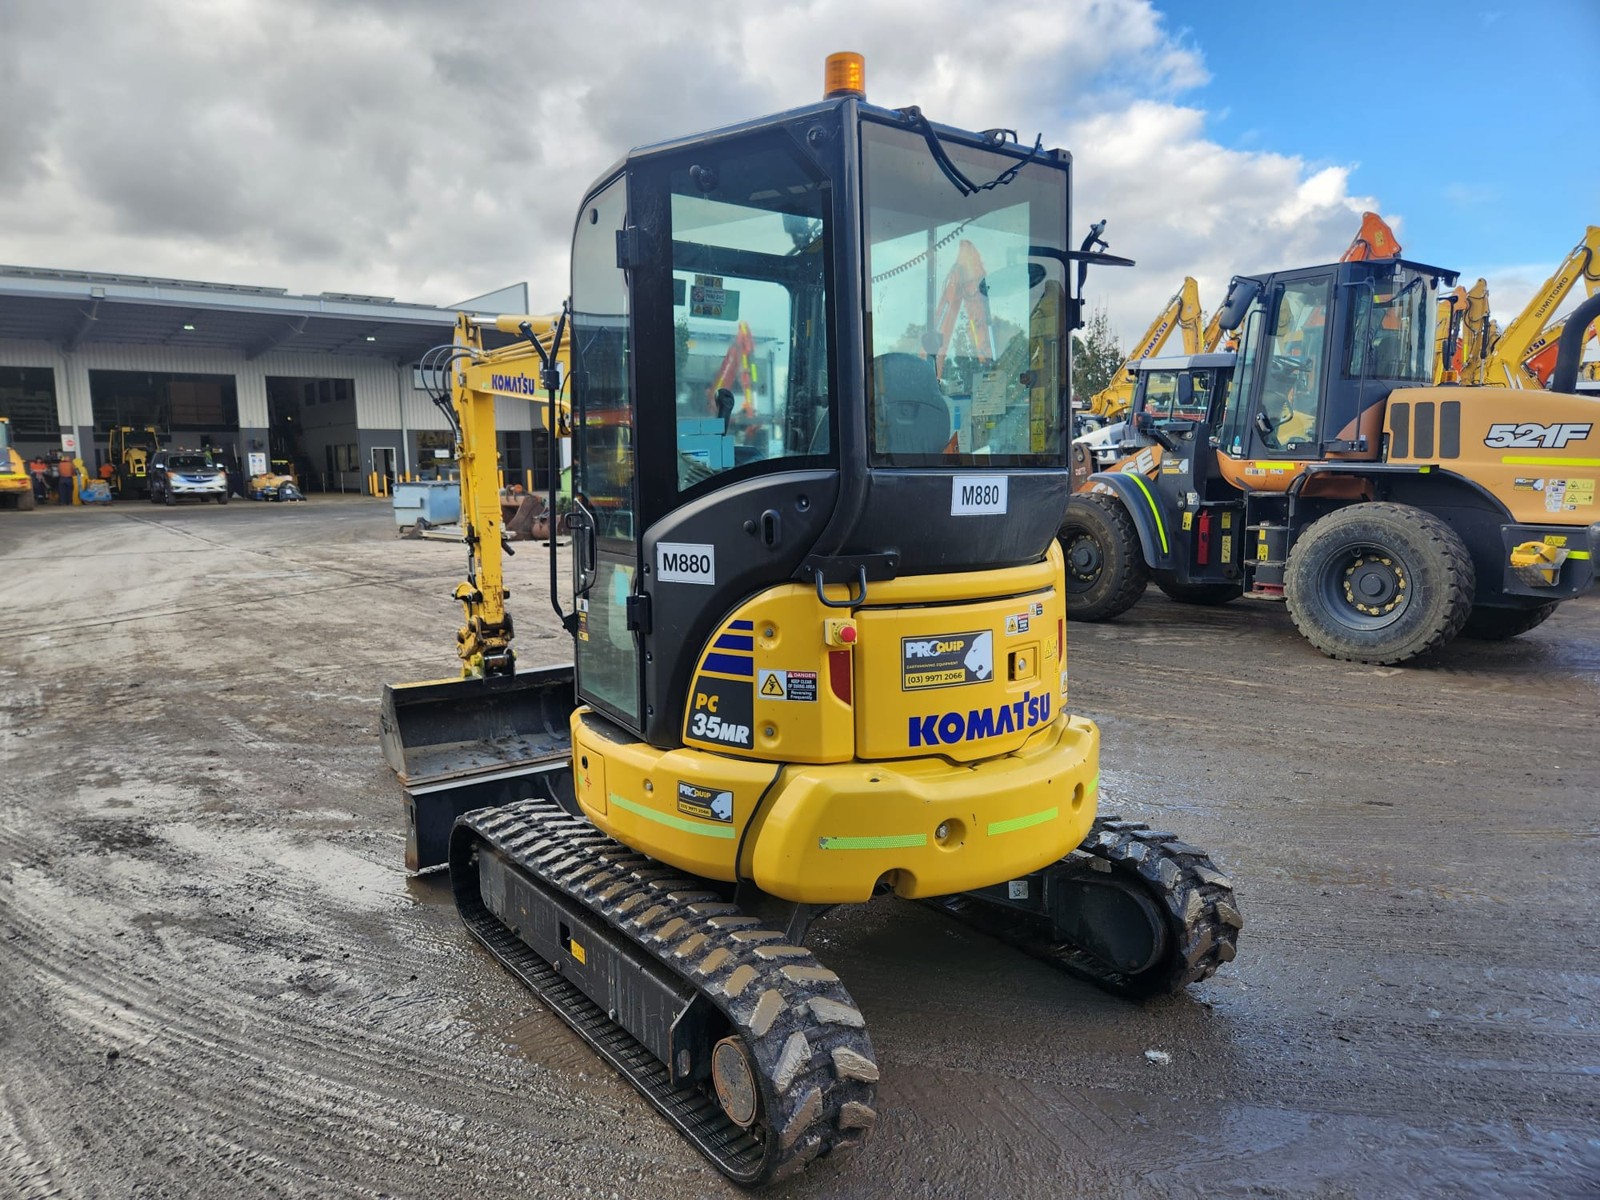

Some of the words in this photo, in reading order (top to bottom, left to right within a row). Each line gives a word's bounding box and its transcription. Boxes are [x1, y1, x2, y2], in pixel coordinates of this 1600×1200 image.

[1535, 276, 1569, 318] SUMITOMO
[492, 372, 534, 395] KOMATSU
[1483, 422, 1594, 449] 521F
[962, 484, 1000, 506] M880
[663, 552, 711, 574] M880
[907, 675, 924, 685] (03)
[925, 674, 943, 682] 9971
[944, 672, 963, 680] 2066
[695, 692, 719, 714] PC
[691, 712, 750, 744] 35MR
[908, 691, 1051, 748] KOMATSU
